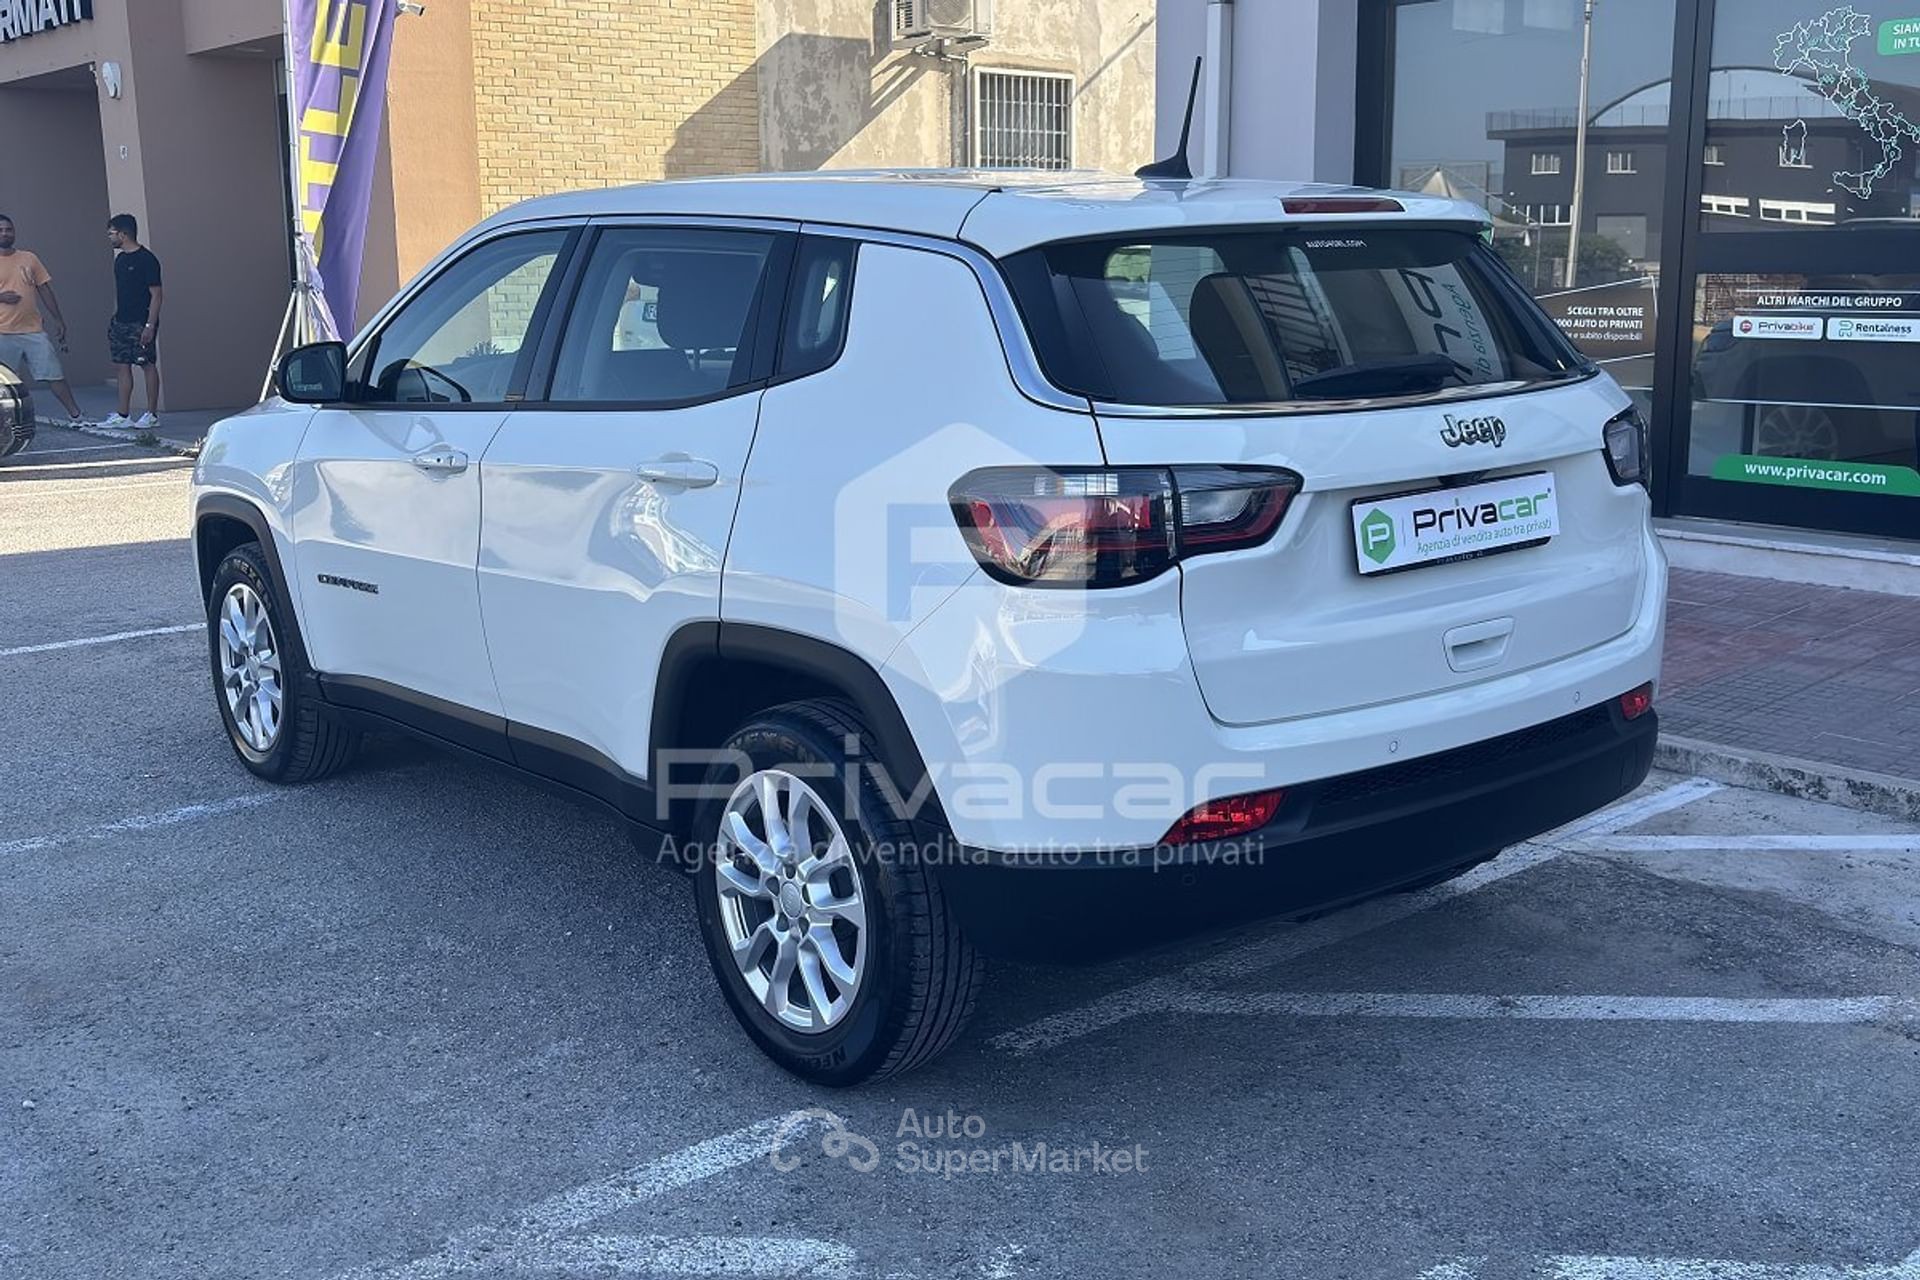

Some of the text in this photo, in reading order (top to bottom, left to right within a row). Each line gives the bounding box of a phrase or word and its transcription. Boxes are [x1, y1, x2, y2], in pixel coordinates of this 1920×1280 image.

[1894, 38, 1906, 48] IN
[1757, 295, 1902, 307] ALTRI MARCHI DEL GRUPPO
[1567, 306, 1644, 317] SCEGLI TRA OLTRE
[1573, 319, 1598, 328] AUTO
[1599, 319, 1608, 328] DI
[1610, 319, 1643, 329] PRIVATI
[1580, 330, 1602, 339] subito
[1603, 330, 1643, 342] disponibili
[1440, 414, 1506, 448] Jeep
[1744, 463, 1887, 486] www.privacar.com
[1412, 492, 1550, 537] Privacar
[1416, 518, 1552, 557] Agenzia di vendita auto tra privati
